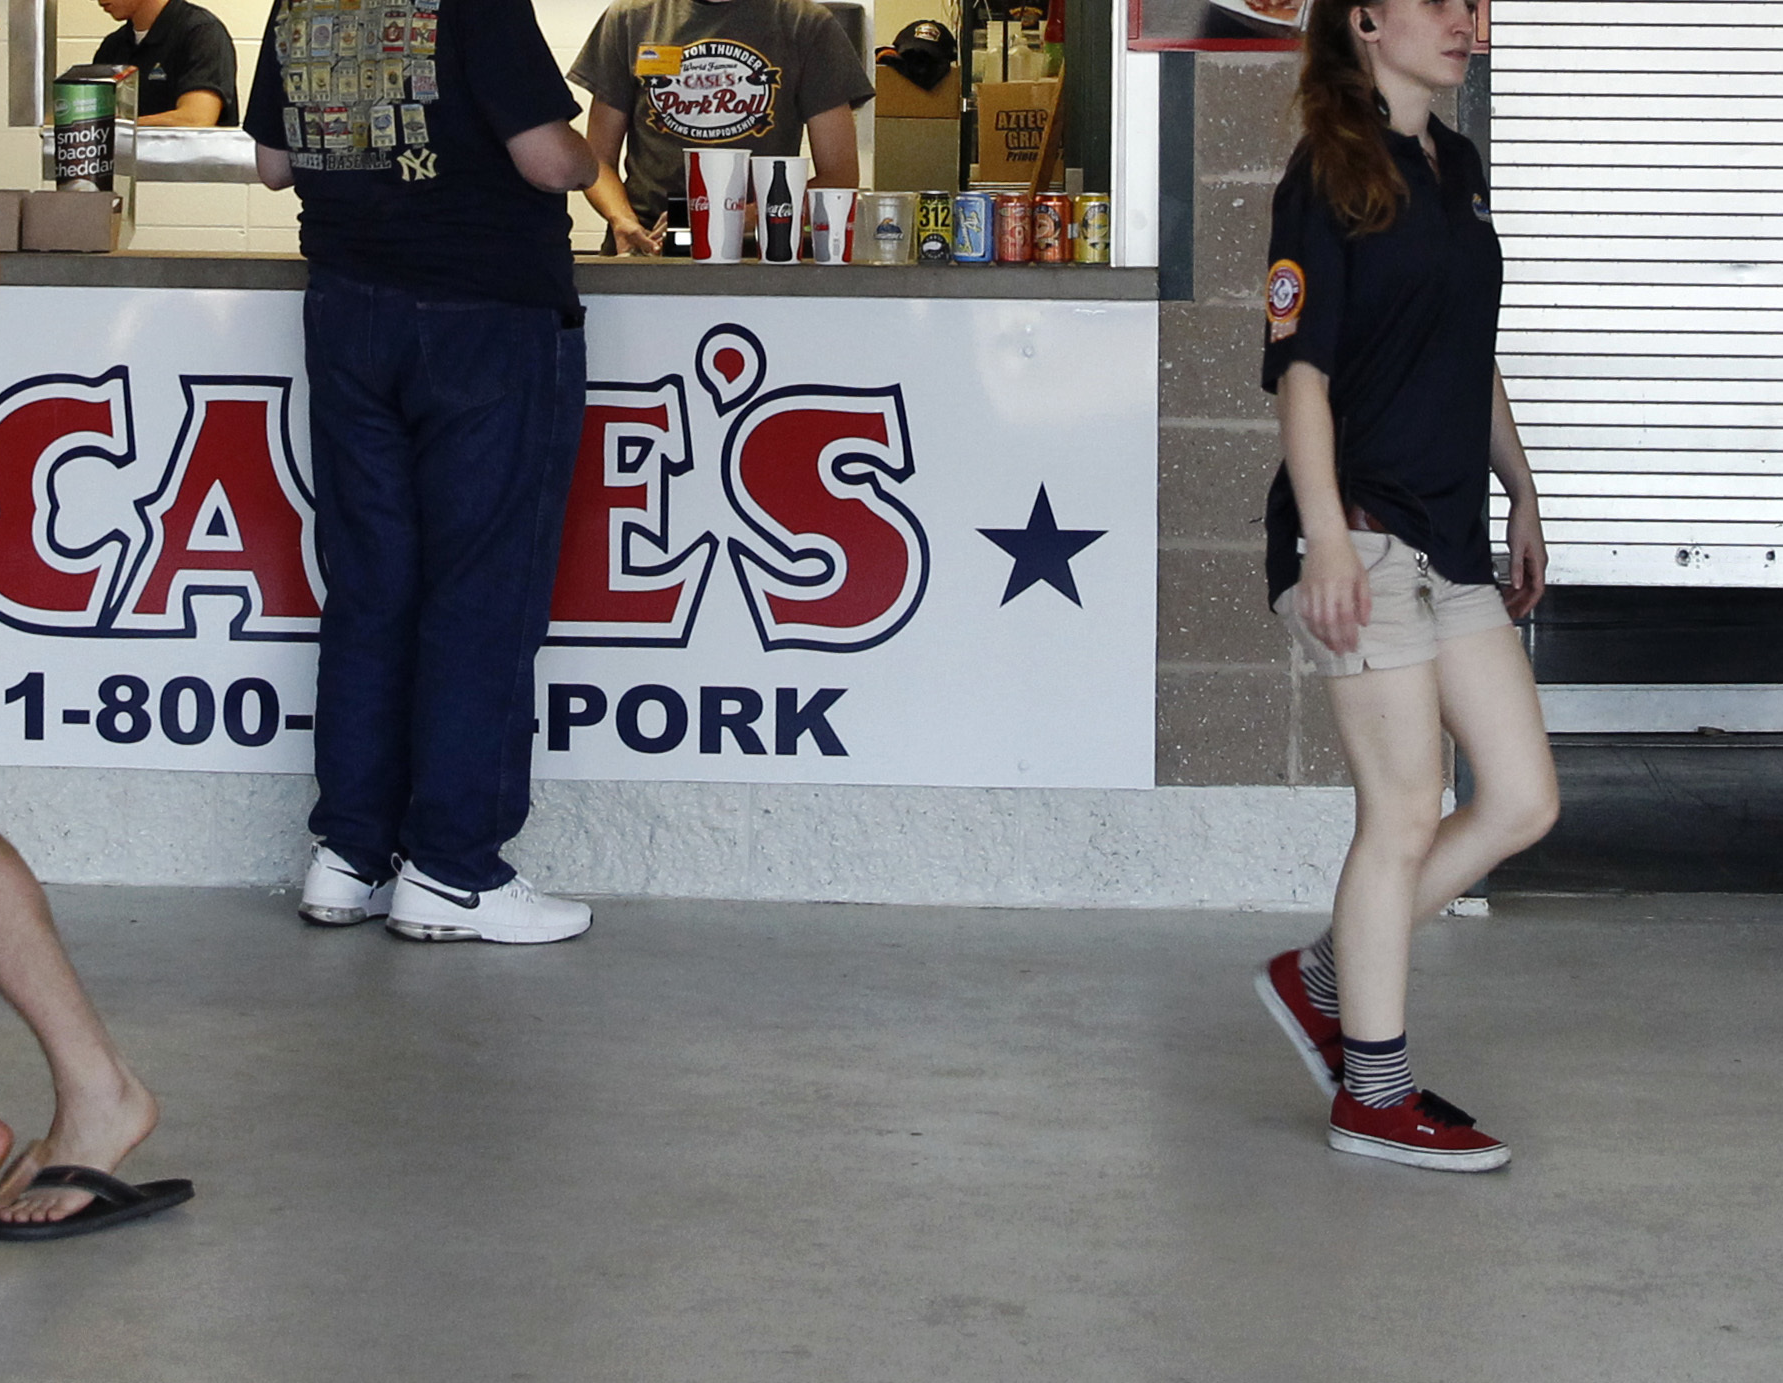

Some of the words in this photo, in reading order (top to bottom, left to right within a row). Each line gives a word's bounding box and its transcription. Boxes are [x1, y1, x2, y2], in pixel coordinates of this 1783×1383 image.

[710, 43, 763, 71] THUNDER
[655, 91, 712, 114] Pork
[713, 89, 765, 114] Roll
[57, 125, 110, 145] smoky
[690, 116, 756, 139] CHAMPIONSHIP
[58, 143, 107, 160] bacon
[396, 148, 438, 182] NY
[919, 206, 952, 228] 312
